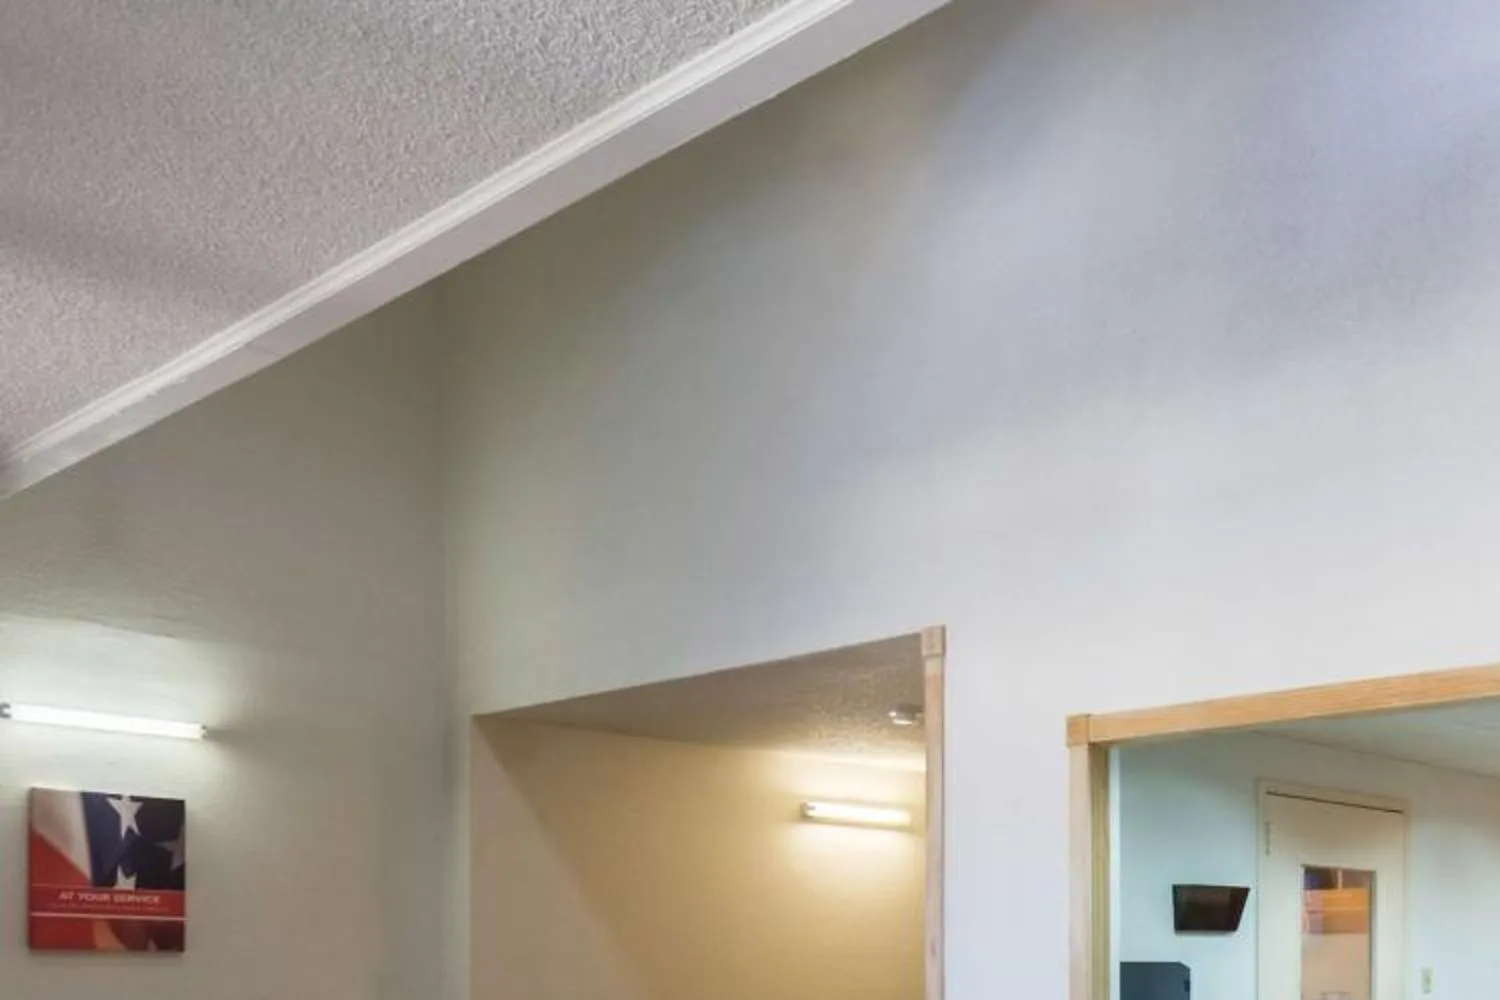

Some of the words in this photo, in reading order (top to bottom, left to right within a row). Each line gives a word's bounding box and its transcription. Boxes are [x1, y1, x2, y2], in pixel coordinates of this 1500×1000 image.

[58, 891, 75, 901] AT
[78, 892, 110, 902] YOUR
[113, 894, 161, 904] SERVICE
